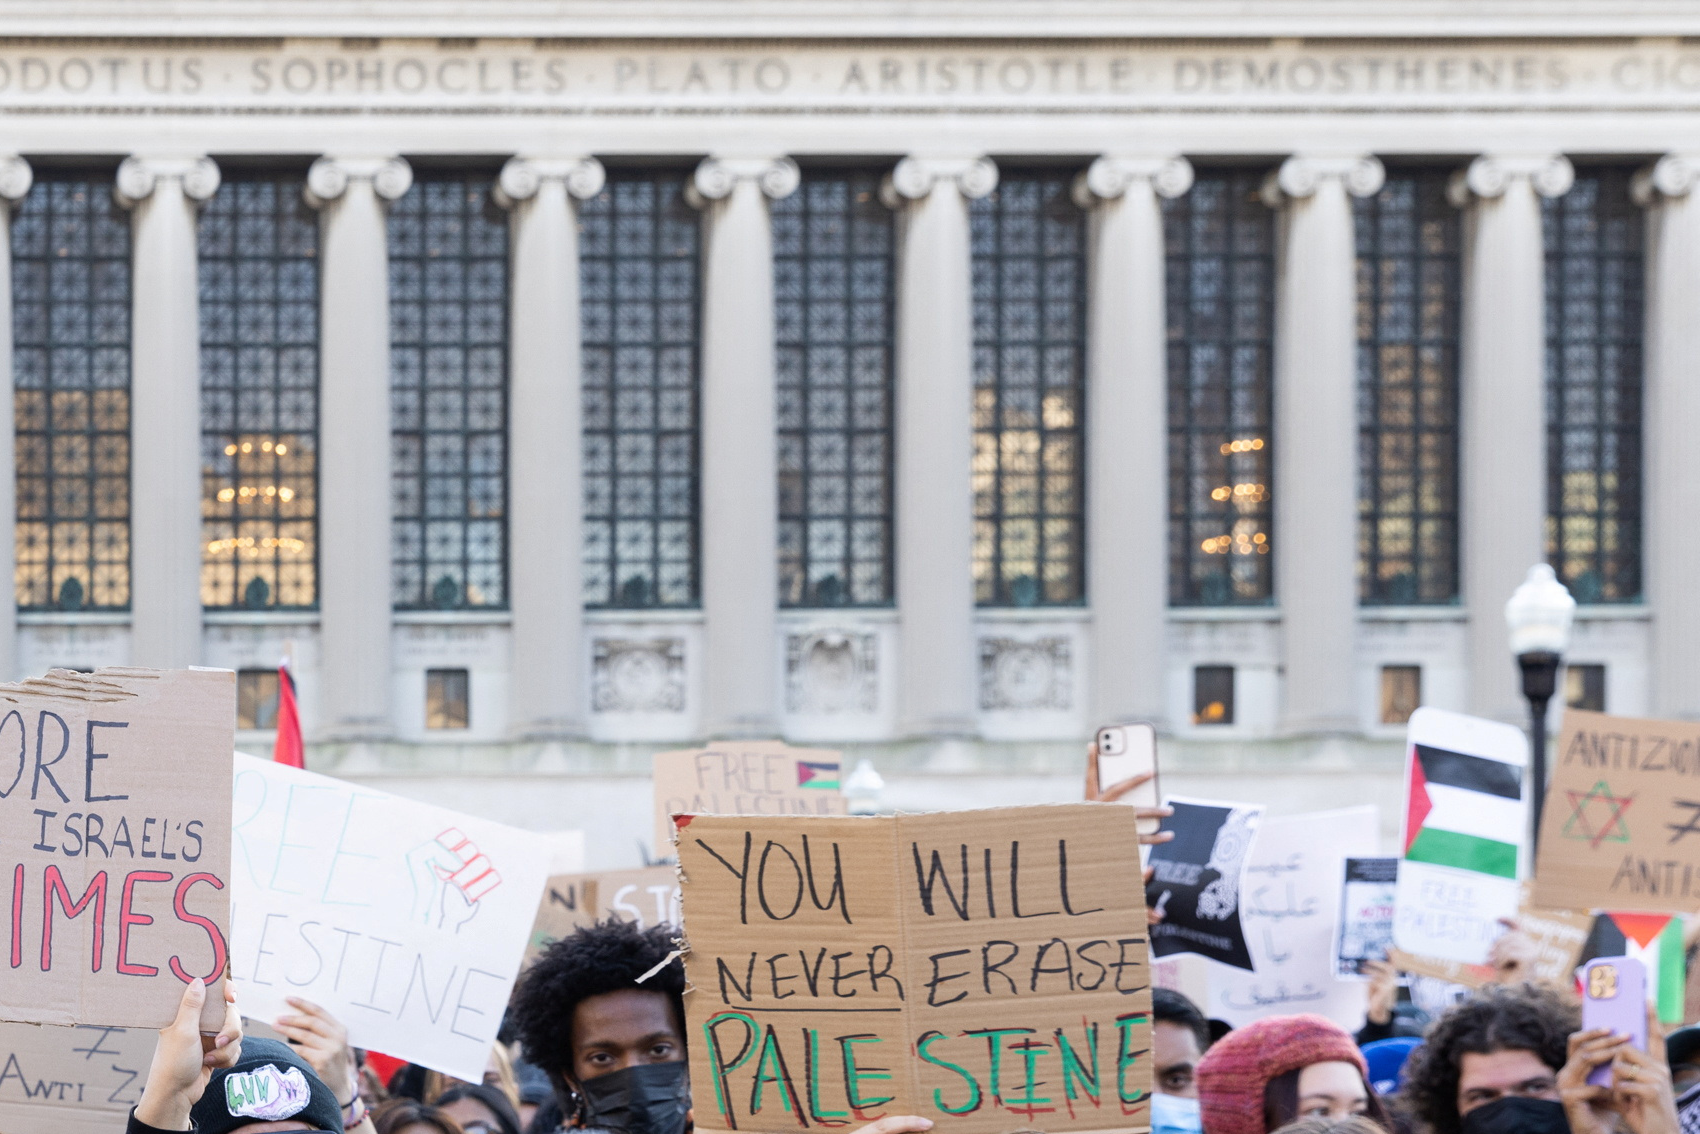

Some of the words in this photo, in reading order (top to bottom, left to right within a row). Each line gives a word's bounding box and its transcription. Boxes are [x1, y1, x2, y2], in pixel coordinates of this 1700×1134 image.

[250, 56, 568, 95] SOPHOCLES
[614, 57, 791, 95] PLATO
[838, 57, 1133, 95] ARISTOTLE
[1173, 56, 1570, 96] DEMOSTHENES
[694, 751, 789, 794] FREE
[32, 807, 205, 863] ISRAEL'S
[695, 831, 854, 925] YOU
[912, 838, 1105, 922] WILL
[1608, 852, 1700, 898] ANTI
[716, 944, 905, 1006] NEVER
[923, 937, 1149, 1007] ERASE
[702, 1009, 1154, 1131] PALESTINE
